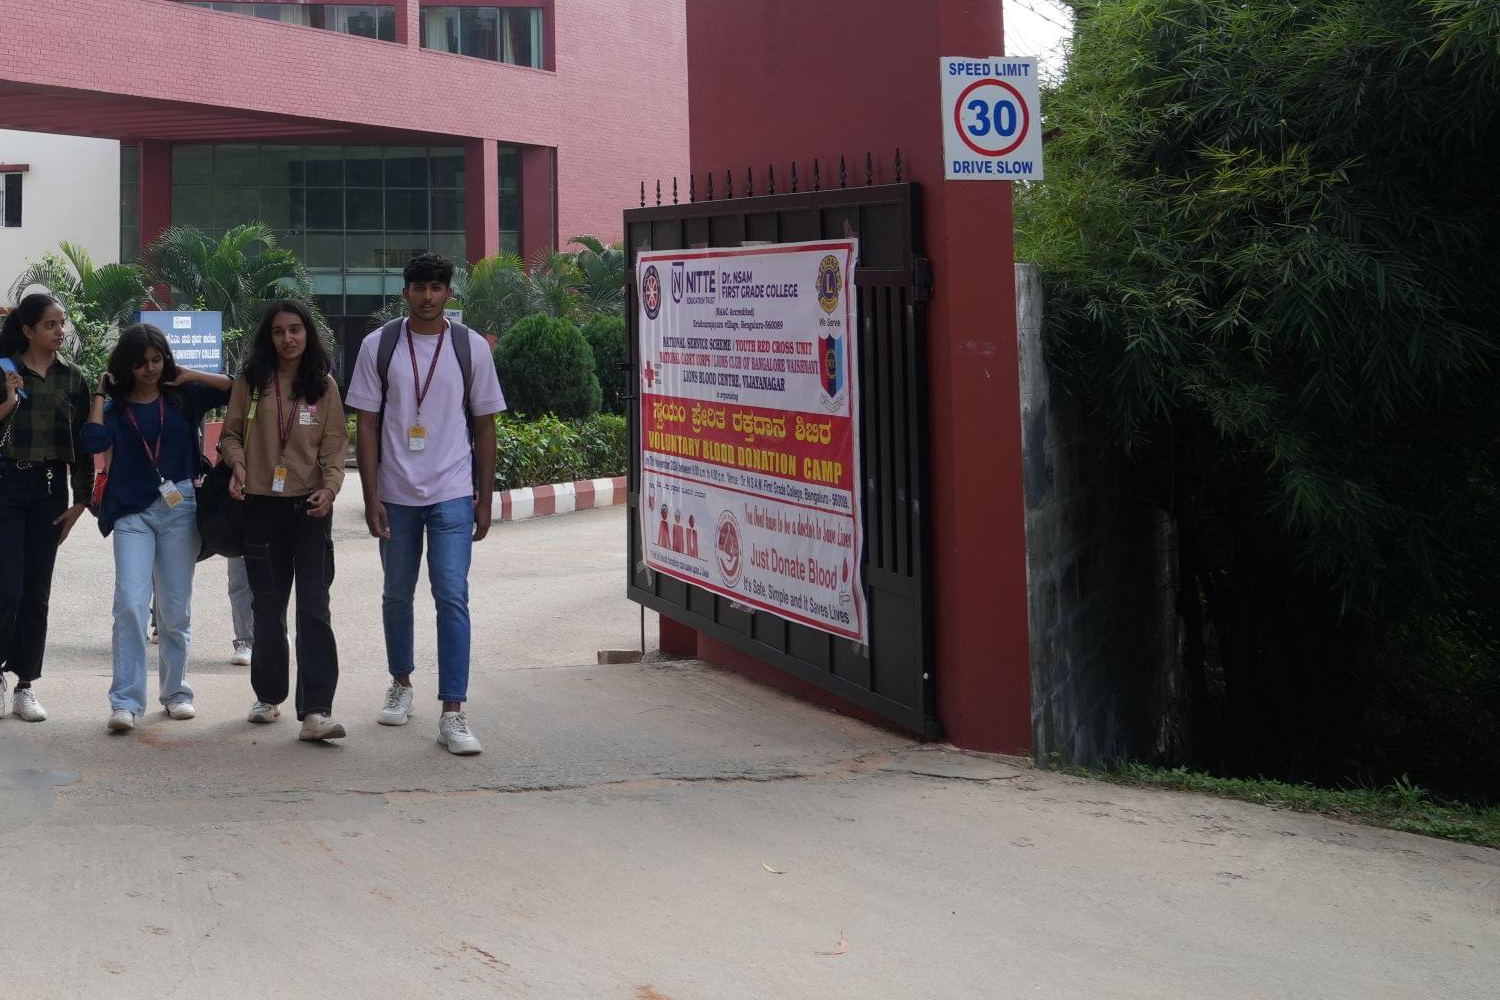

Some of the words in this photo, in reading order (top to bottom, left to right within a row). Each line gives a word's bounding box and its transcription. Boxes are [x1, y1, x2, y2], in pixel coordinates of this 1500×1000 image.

[949, 63, 991, 76] SPEED
[995, 63, 1030, 76] LIMIT
[967, 99, 1017, 137] 30
[953, 161, 992, 174] DRIVE
[997, 161, 1033, 174] SLOW
[687, 271, 716, 293] NITTE
[722, 272, 732, 284] Dr.
[733, 271, 753, 284] NSAM
[722, 286, 739, 298] FIRST
[741, 285, 764, 298] GRADE
[766, 284, 798, 298] COLLEGE
[663, 337, 685, 348] NATIONAL
[687, 338, 708, 350] SERVICE
[709, 339, 731, 351] SCHEME
[736, 340, 756, 353] YOUTH
[757, 341, 770, 353] RED
[772, 341, 793, 354] CROSS
[796, 342, 813, 355] UNIT
[660, 352, 680, 364] NATIONAL
[696, 354, 710, 367] CORPS
[743, 357, 750, 370] OF
[751, 358, 785, 373] BANGALORE
[683, 370, 697, 383] LIONS
[699, 371, 716, 385] BLOOD
[742, 374, 786, 392] VIJAYANAGAR
[648, 430, 700, 458] VOLUNTARY
[702, 439, 734, 465] BLOOD
[737, 446, 797, 476] DONATION
[803, 457, 842, 484] CAMP
[750, 543, 770, 571] Just
[771, 547, 805, 581] Donate
[808, 558, 837, 591] Blood
[743, 575, 752, 593] It's
[752, 579, 767, 600] Safe,
[768, 584, 789, 607] Simple
[790, 593, 802, 609] and
[804, 594, 809, 611] it
[809, 597, 829, 618] Saves
[829, 603, 850, 625] Lives
